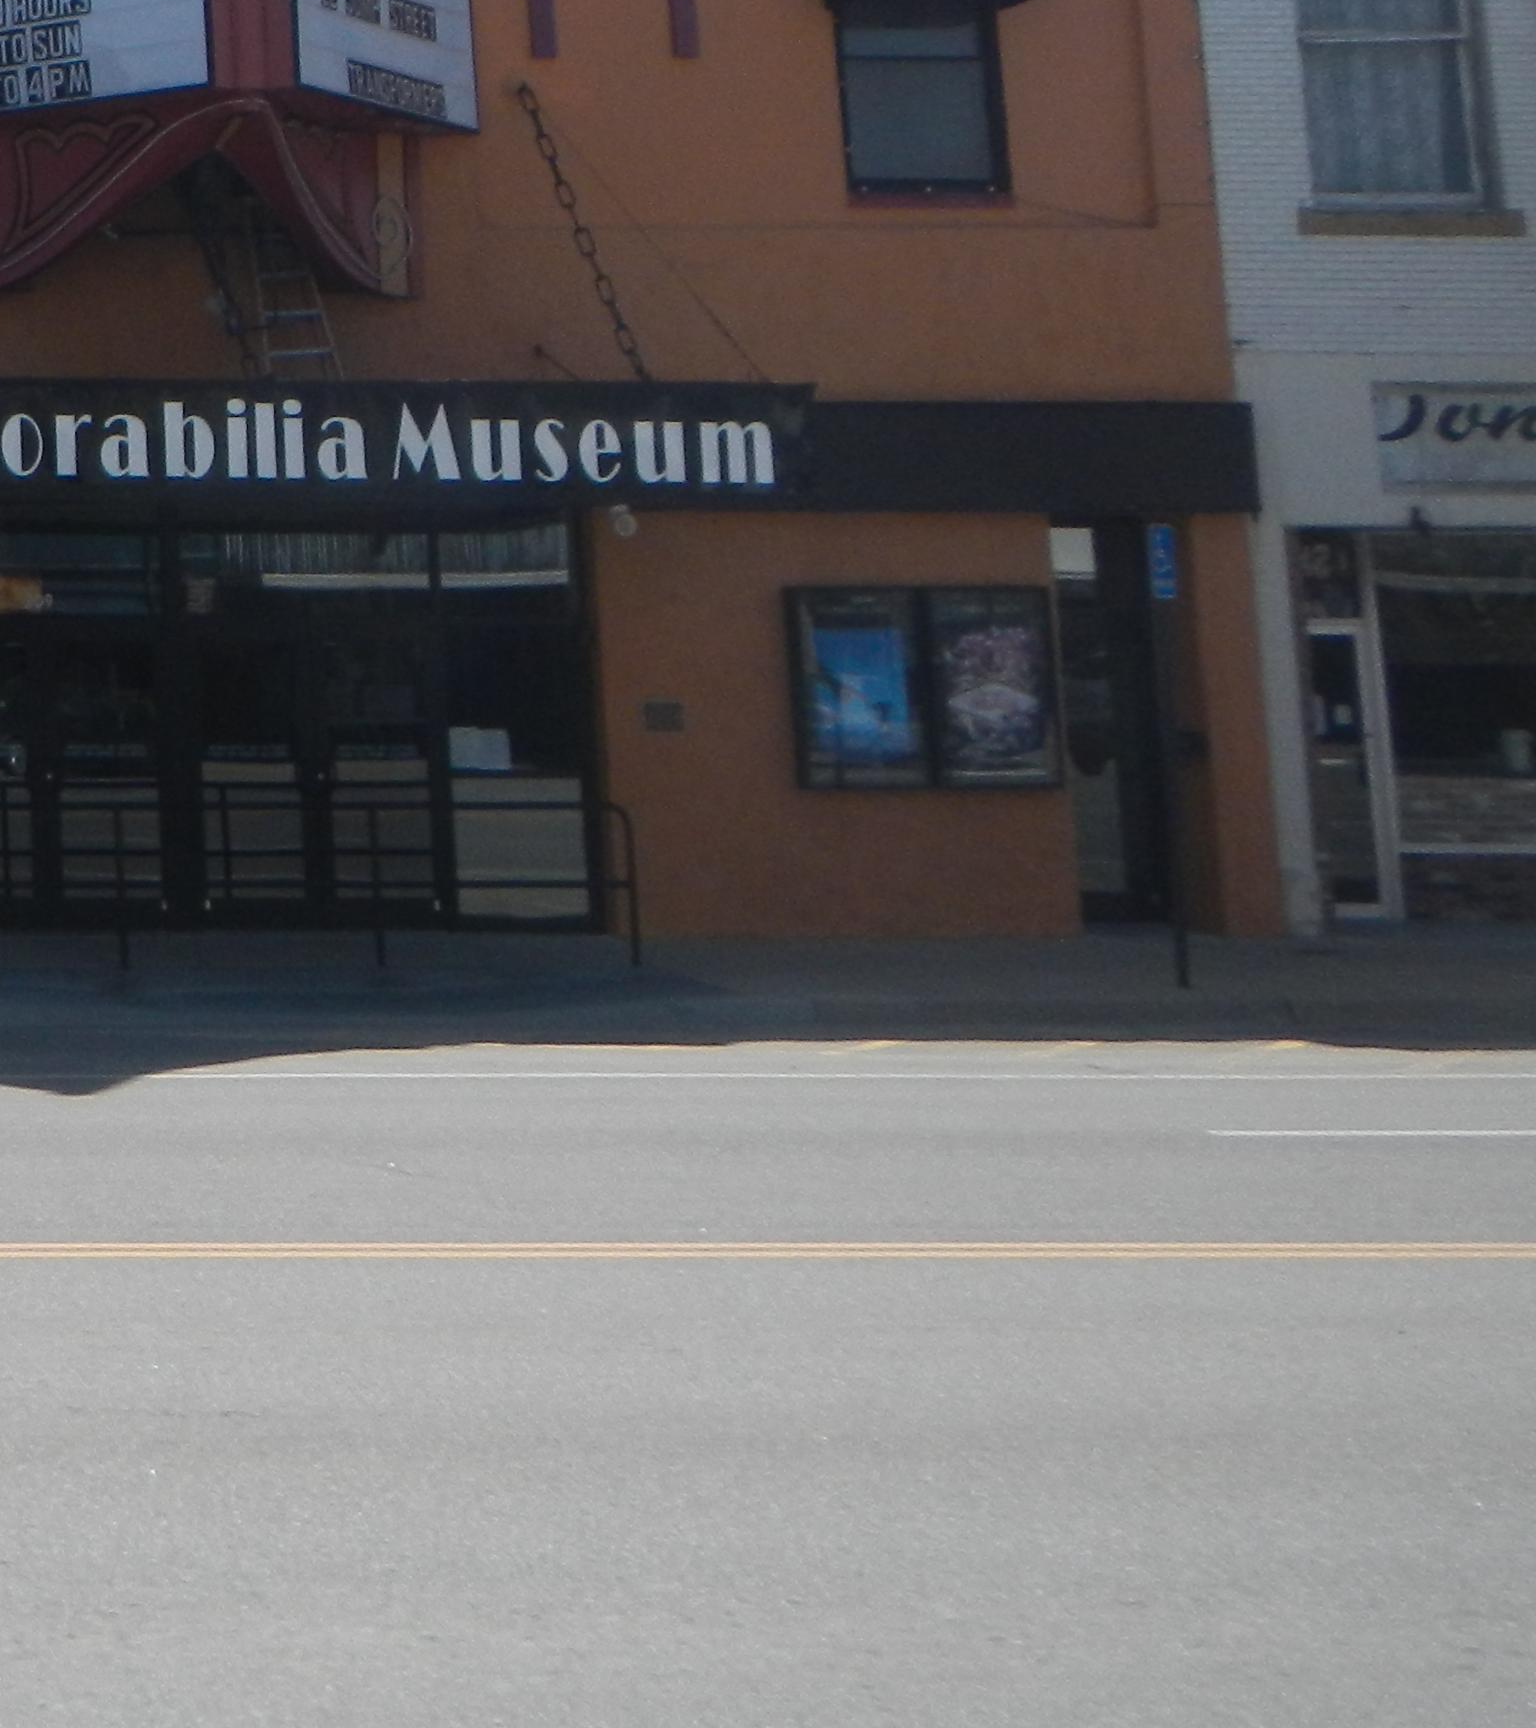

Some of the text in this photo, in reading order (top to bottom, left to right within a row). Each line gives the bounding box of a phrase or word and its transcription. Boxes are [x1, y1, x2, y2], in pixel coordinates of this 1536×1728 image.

[32, 21, 82, 62] SUN
[27, 67, 45, 104] 4
[48, 61, 92, 100] PM
[391, 401, 777, 486] Museum
